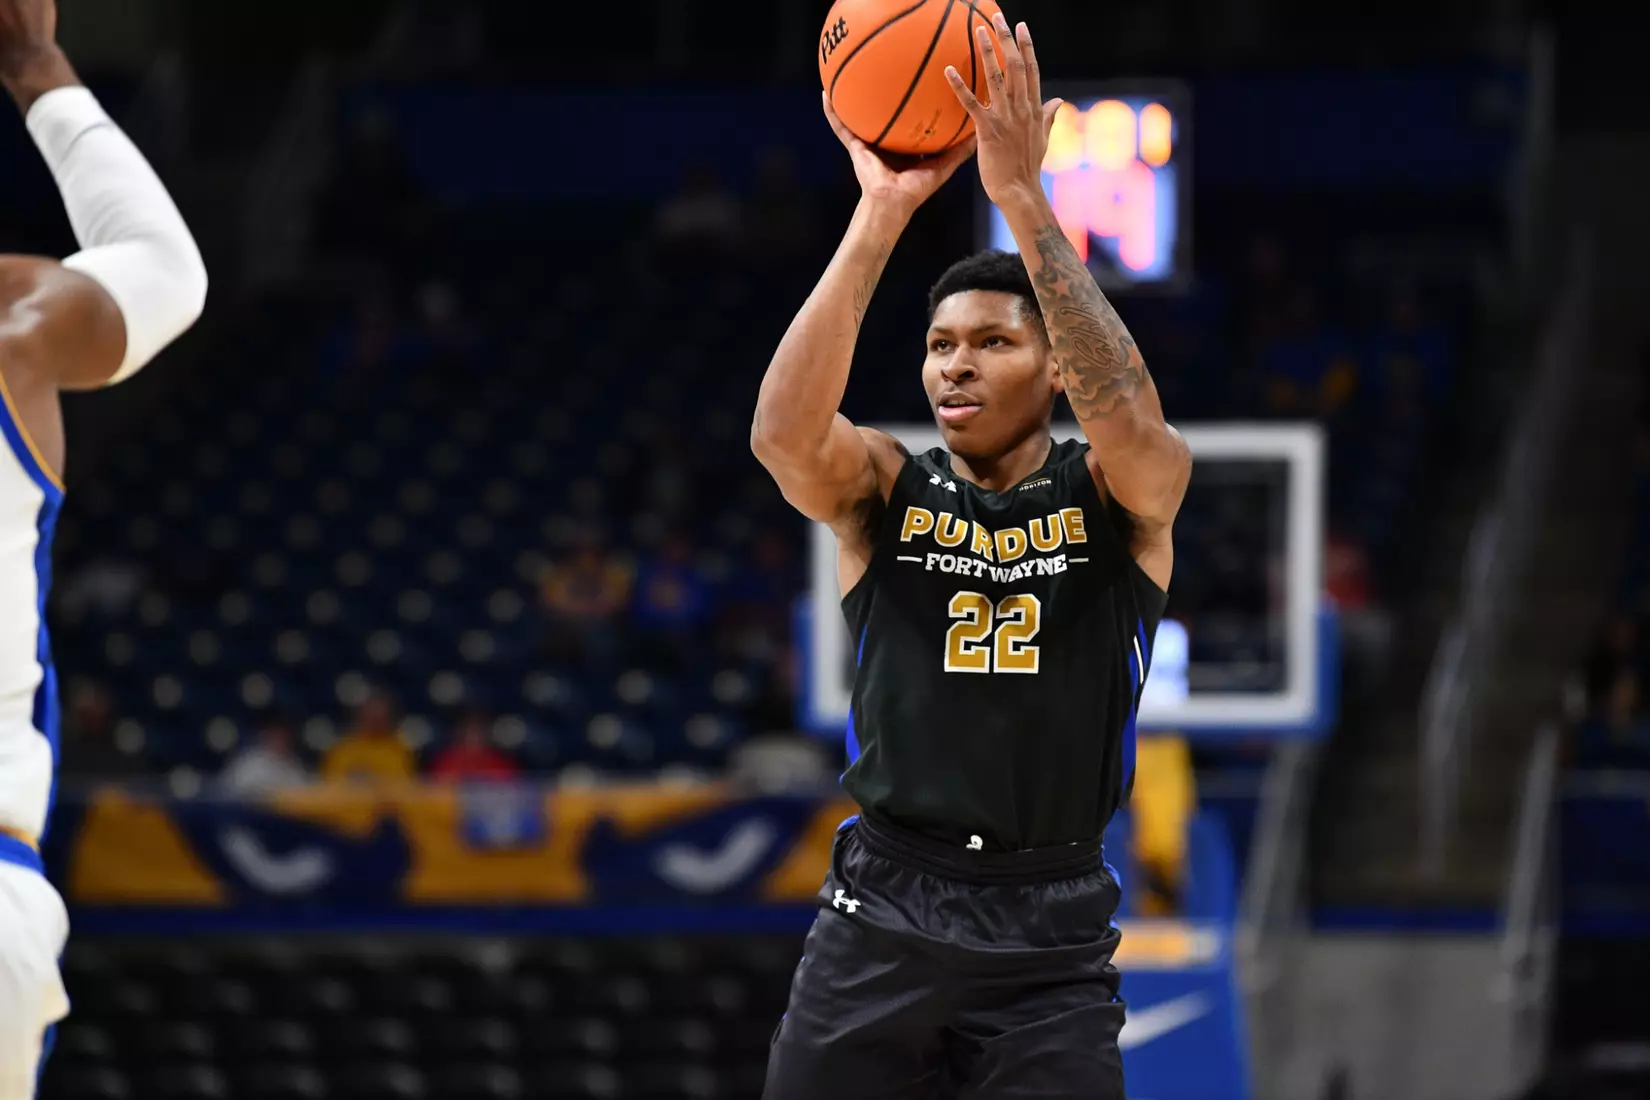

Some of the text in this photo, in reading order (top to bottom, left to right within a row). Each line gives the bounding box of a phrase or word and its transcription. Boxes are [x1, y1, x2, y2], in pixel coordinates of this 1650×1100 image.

[821, 16, 849, 65] Pitt
[1019, 479, 1052, 491] HORIZON
[900, 506, 1088, 563] PURDUE
[925, 552, 1068, 583] FORT WAYNE
[944, 590, 1041, 674] 22
